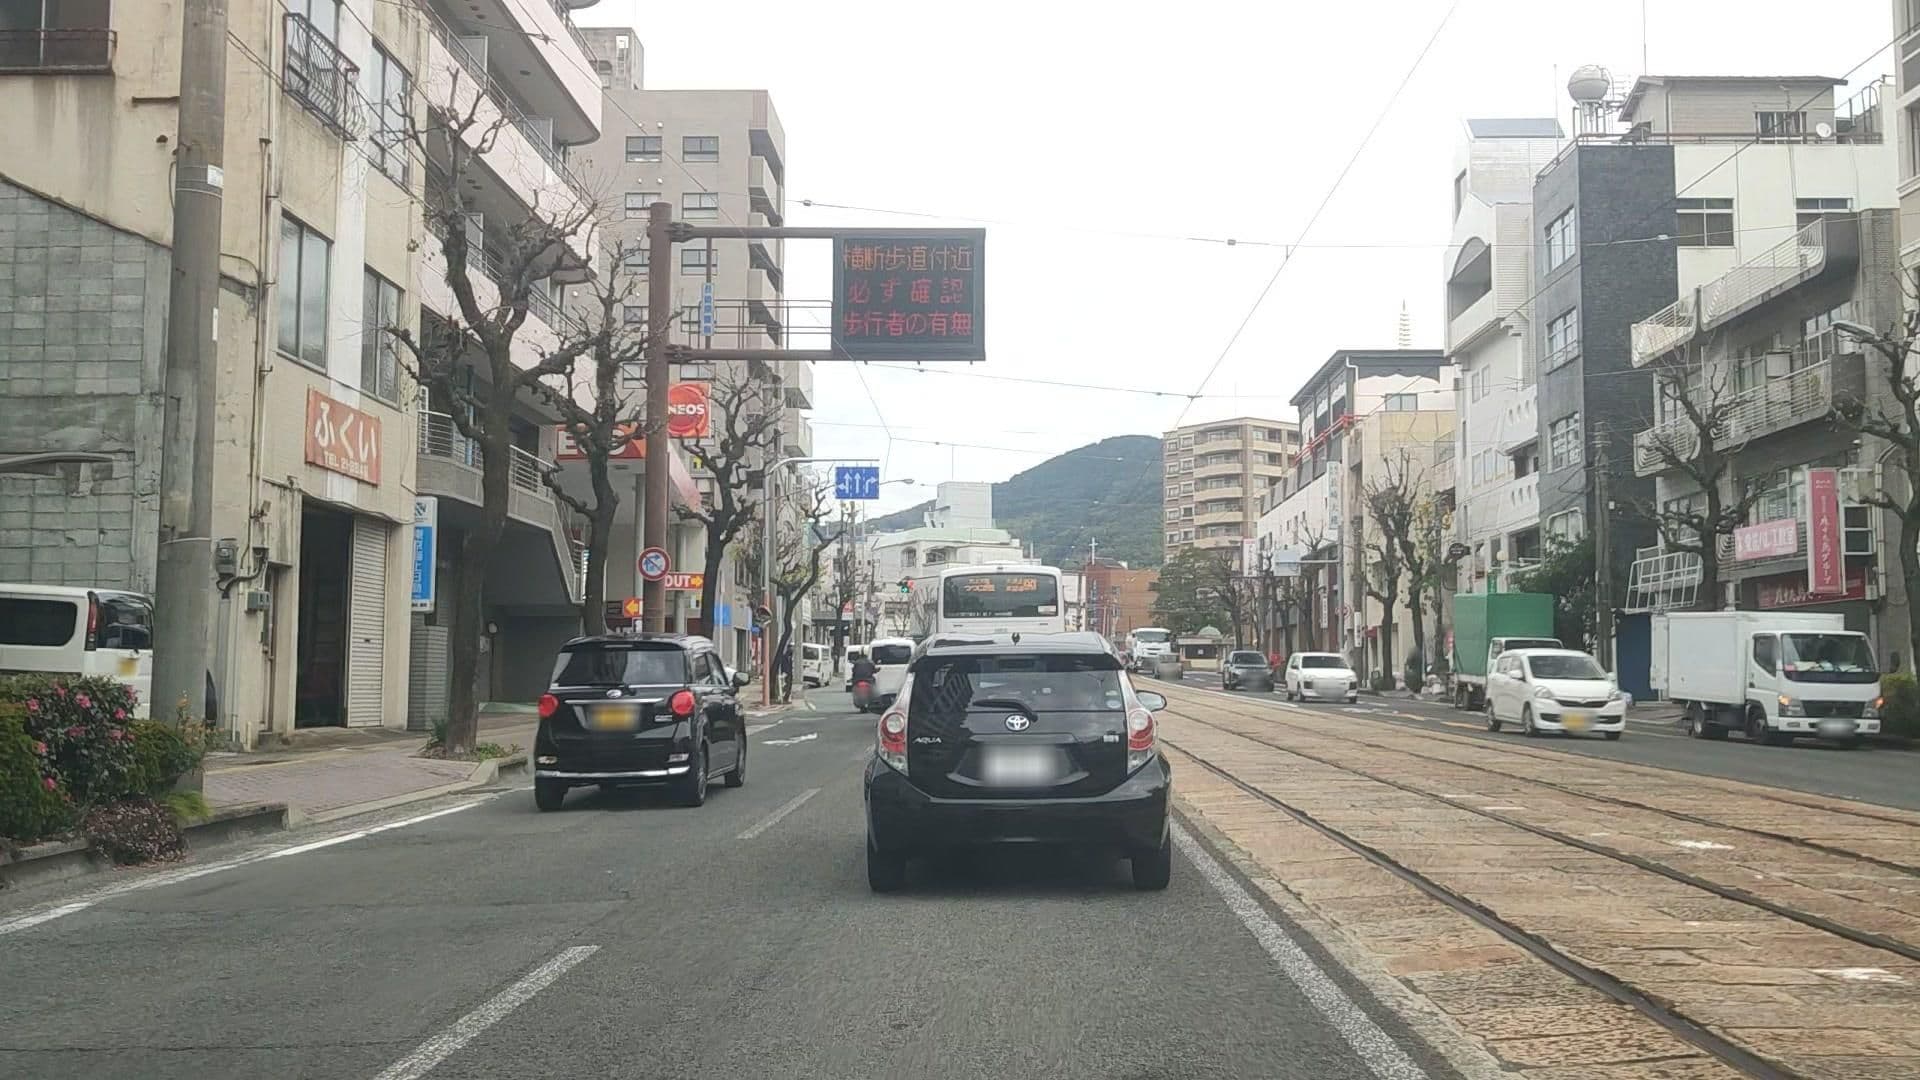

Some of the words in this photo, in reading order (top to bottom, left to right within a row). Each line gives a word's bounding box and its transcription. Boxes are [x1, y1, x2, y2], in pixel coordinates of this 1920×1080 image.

[843, 245, 972, 271] 横断歩道付近
[848, 278, 964, 304] 必ず確認
[844, 310, 972, 336] 歩行者の有無
[668, 403, 705, 415] NEOS
[314, 401, 377, 459] ふくい
[324, 450, 339, 468] TEL
[664, 575, 690, 587] OUT
[912, 736, 943, 744] AQUA
